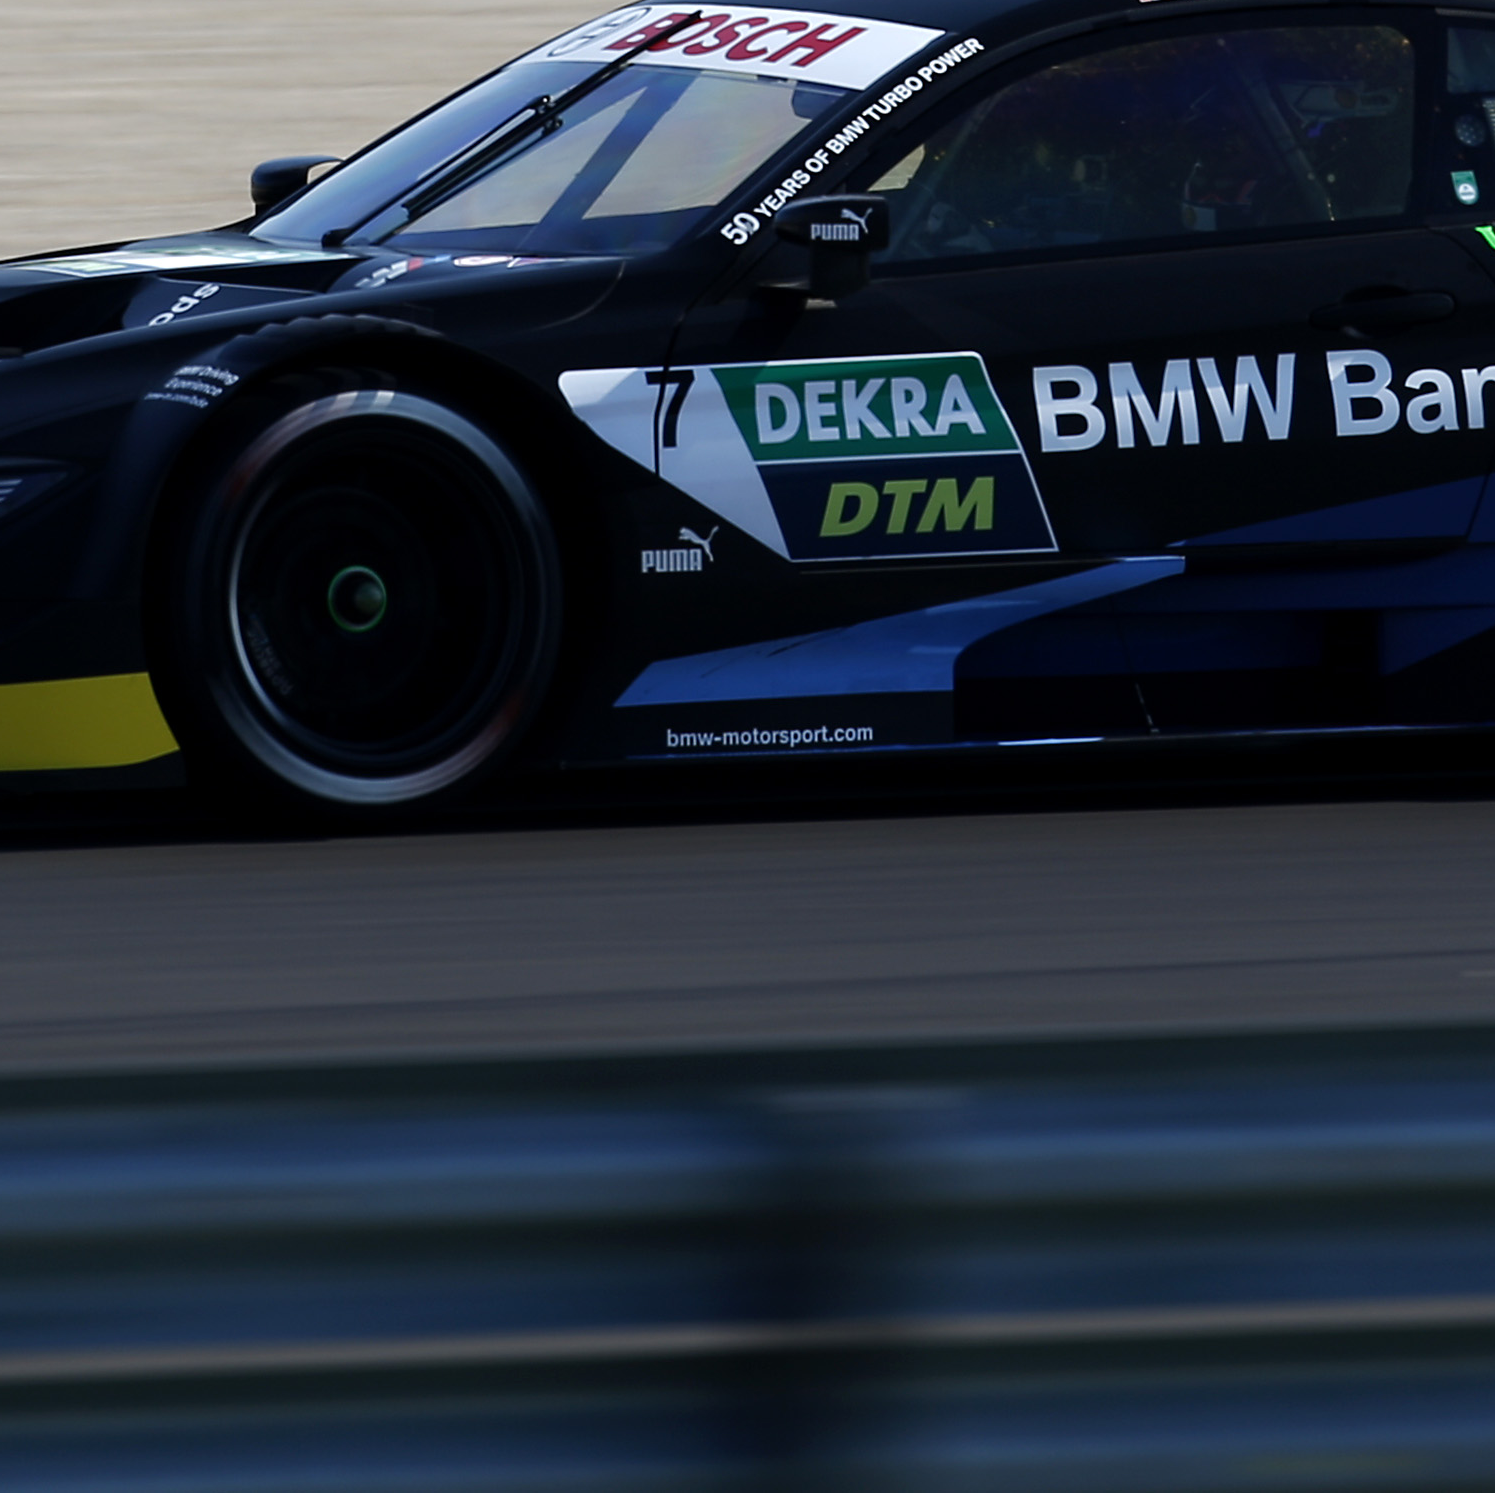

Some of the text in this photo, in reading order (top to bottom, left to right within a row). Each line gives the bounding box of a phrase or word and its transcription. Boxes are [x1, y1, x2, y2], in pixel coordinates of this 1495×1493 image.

[603, 12, 866, 67] BOSCH
[721, 38, 985, 246] 50 YEARS OF BMW TURBO POWER
[811, 223, 860, 241] PUMA
[645, 370, 695, 448] 7
[755, 374, 986, 444] DEKRA
[1033, 353, 1296, 452] BMW
[818, 476, 995, 537] DTM
[641, 547, 703, 574] PUMA
[666, 724, 874, 749] bmw-motorsport.com
